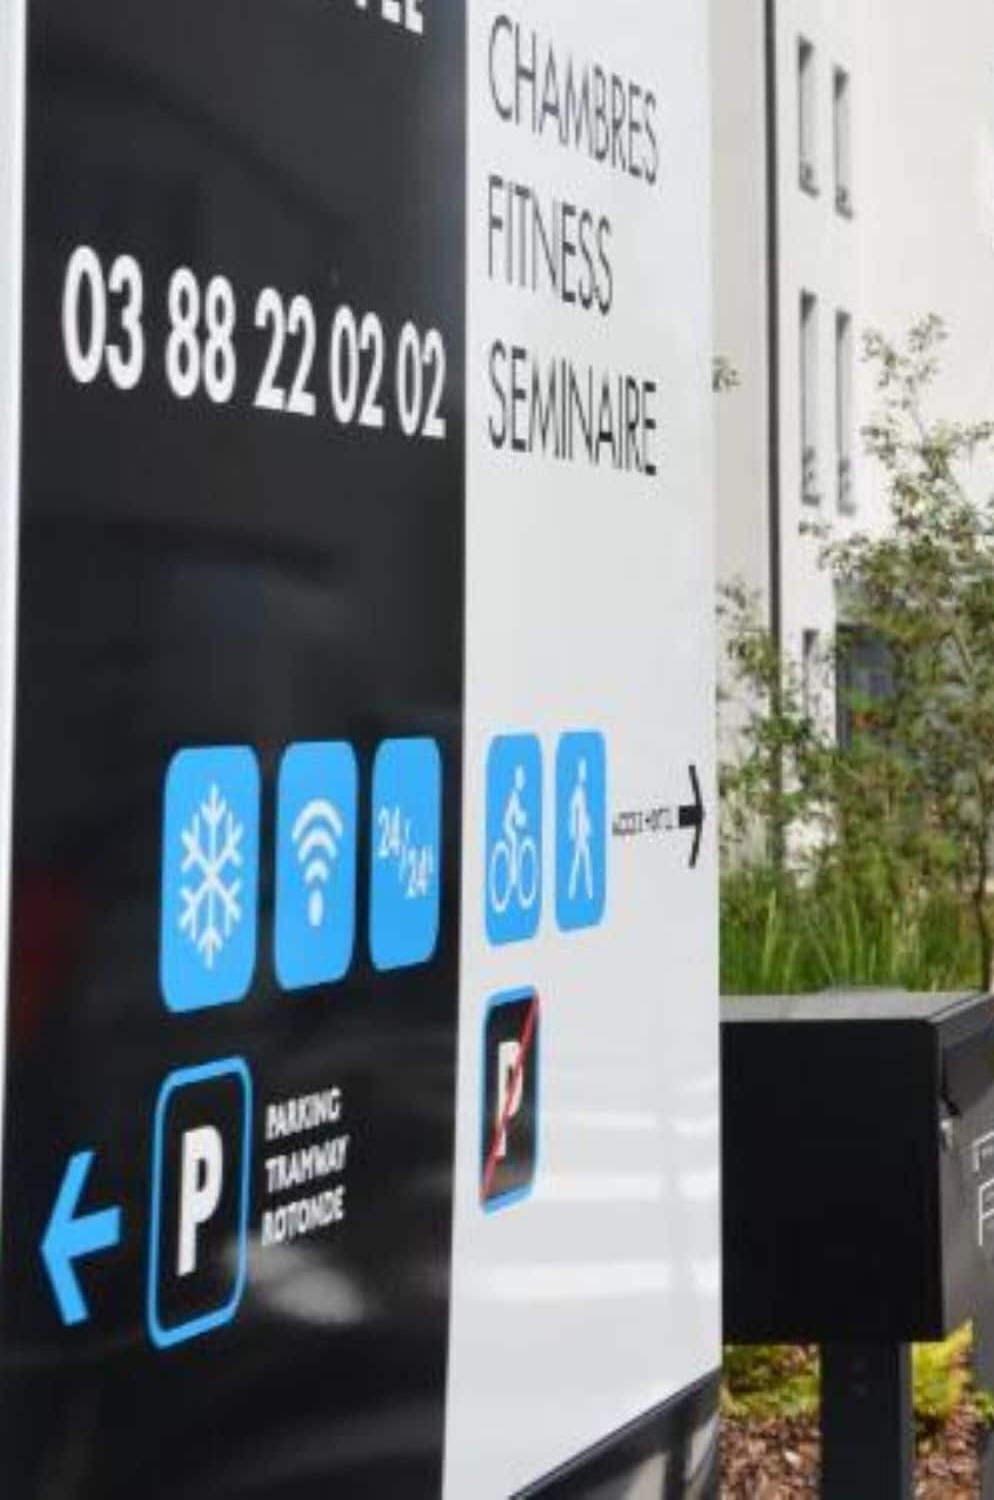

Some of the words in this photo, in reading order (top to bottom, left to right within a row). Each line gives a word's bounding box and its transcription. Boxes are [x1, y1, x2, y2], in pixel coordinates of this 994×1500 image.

[488, 14, 658, 185] CHAMBRES
[488, 175, 613, 316] FITNESS
[63, 245, 145, 389] 03
[166, 266, 236, 403] 88
[253, 288, 316, 416] 22
[330, 305, 384, 428] 02
[398, 322, 446, 439] 02
[488, 340, 657, 476] SEMINAIRE
[265, 1088, 342, 1141] PARKING
[265, 1135, 350, 1193] TRAMWAY
[177, 1125, 223, 1277] P
[262, 1188, 344, 1247] ROTONDE
